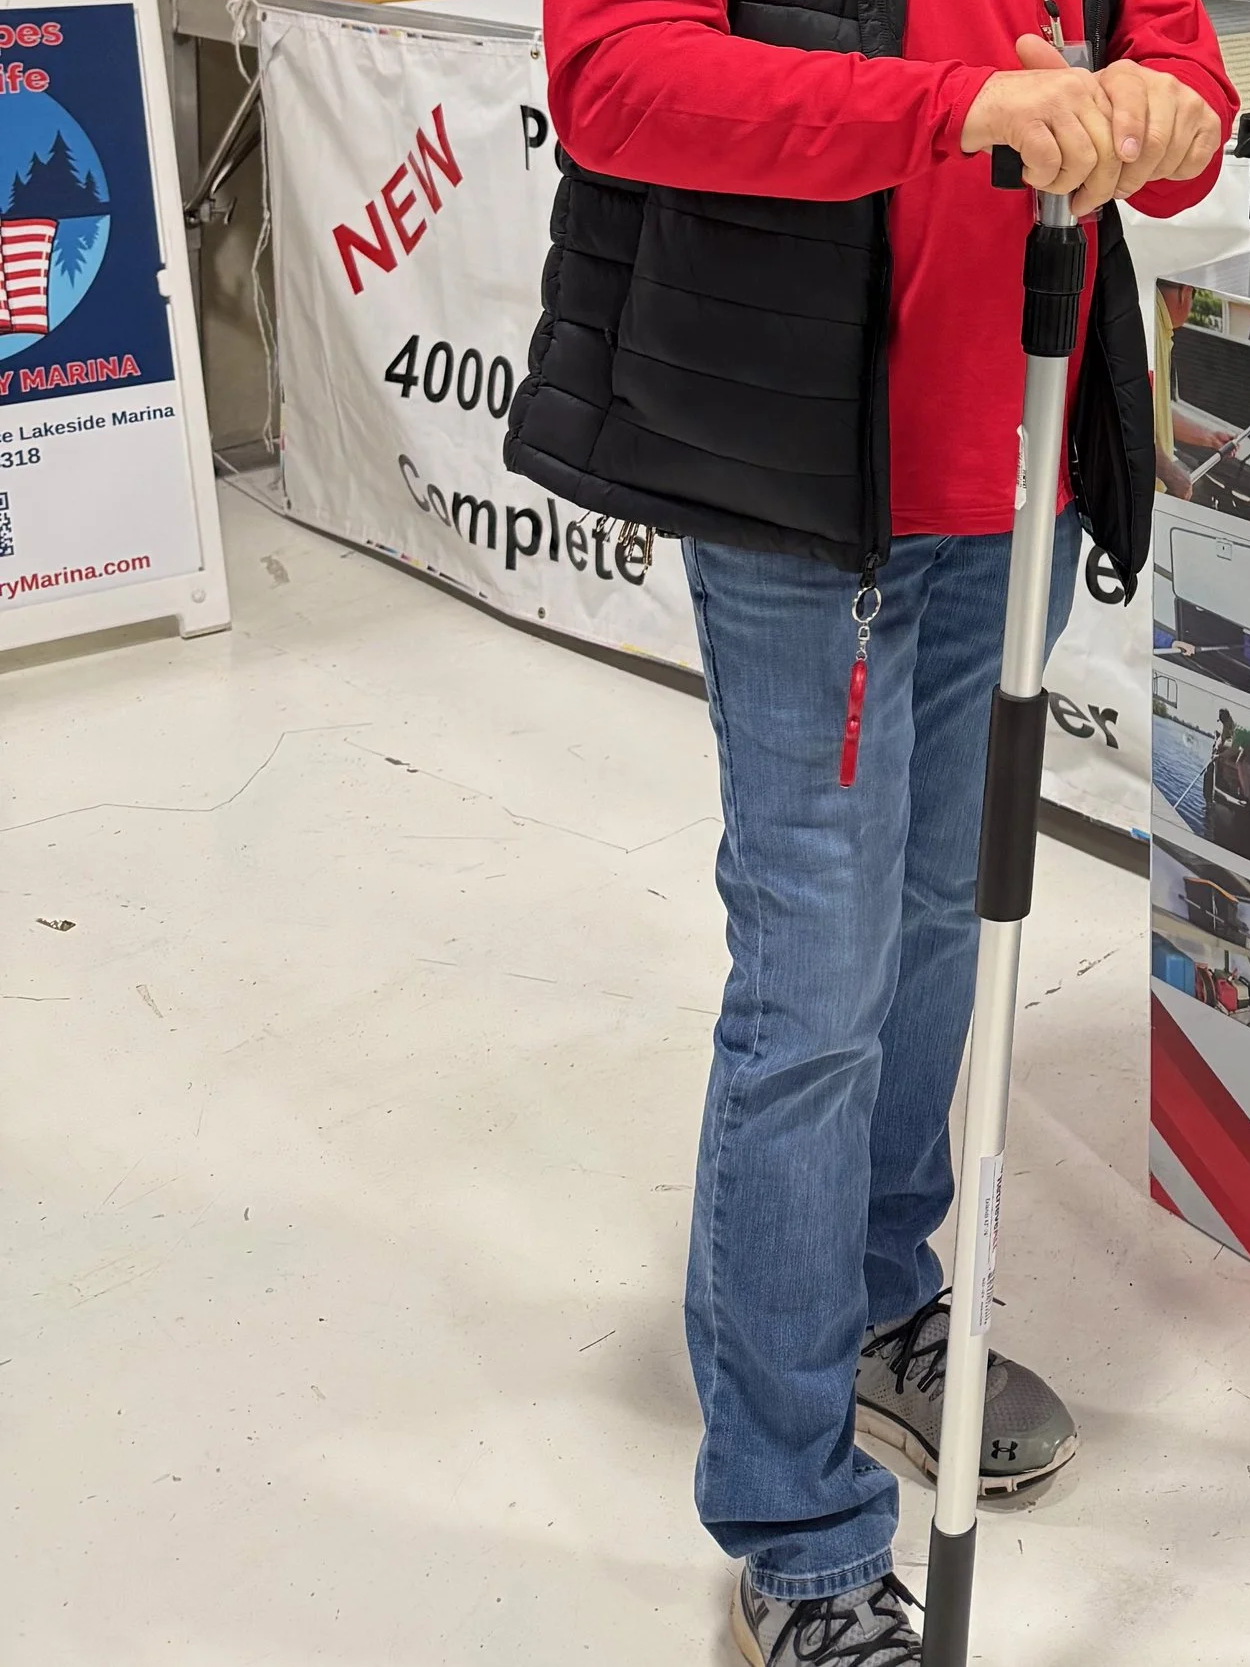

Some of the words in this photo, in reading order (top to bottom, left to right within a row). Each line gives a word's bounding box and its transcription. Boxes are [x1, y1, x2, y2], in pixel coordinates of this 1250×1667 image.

[332, 102, 464, 296] NEW
[19, 353, 142, 393] MARINA
[19, 416, 106, 442] Lakeside
[112, 405, 176, 427] Marina
[398, 453, 648, 587] Complete
